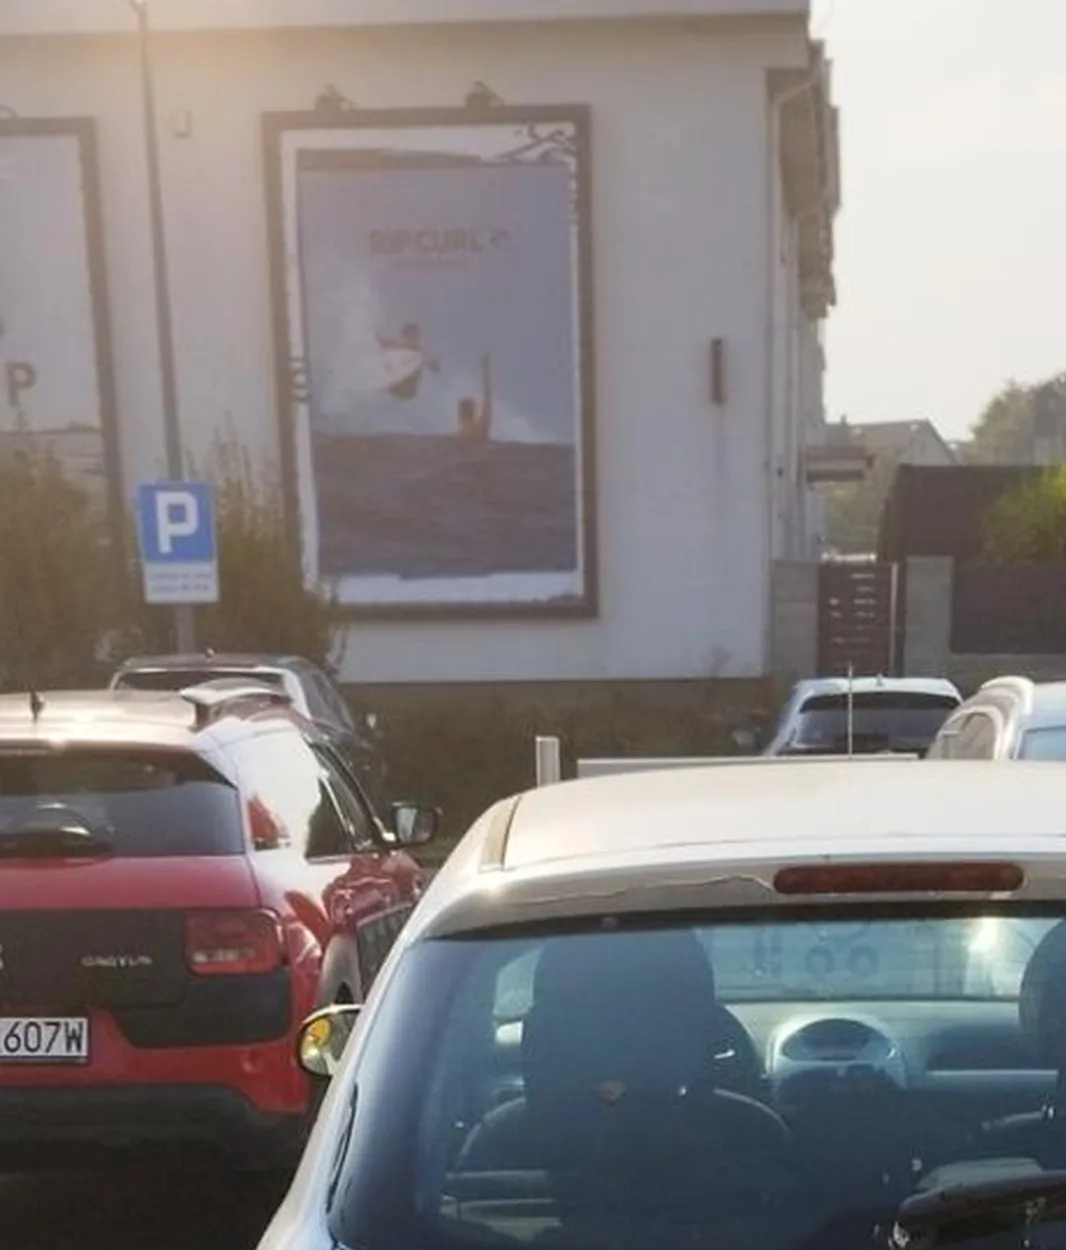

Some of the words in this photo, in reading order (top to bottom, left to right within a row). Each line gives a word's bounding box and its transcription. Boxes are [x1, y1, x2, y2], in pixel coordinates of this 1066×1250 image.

[415, 228, 484, 253] CURL
[157, 491, 199, 554] P
[3, 1020, 83, 1053] 607W
